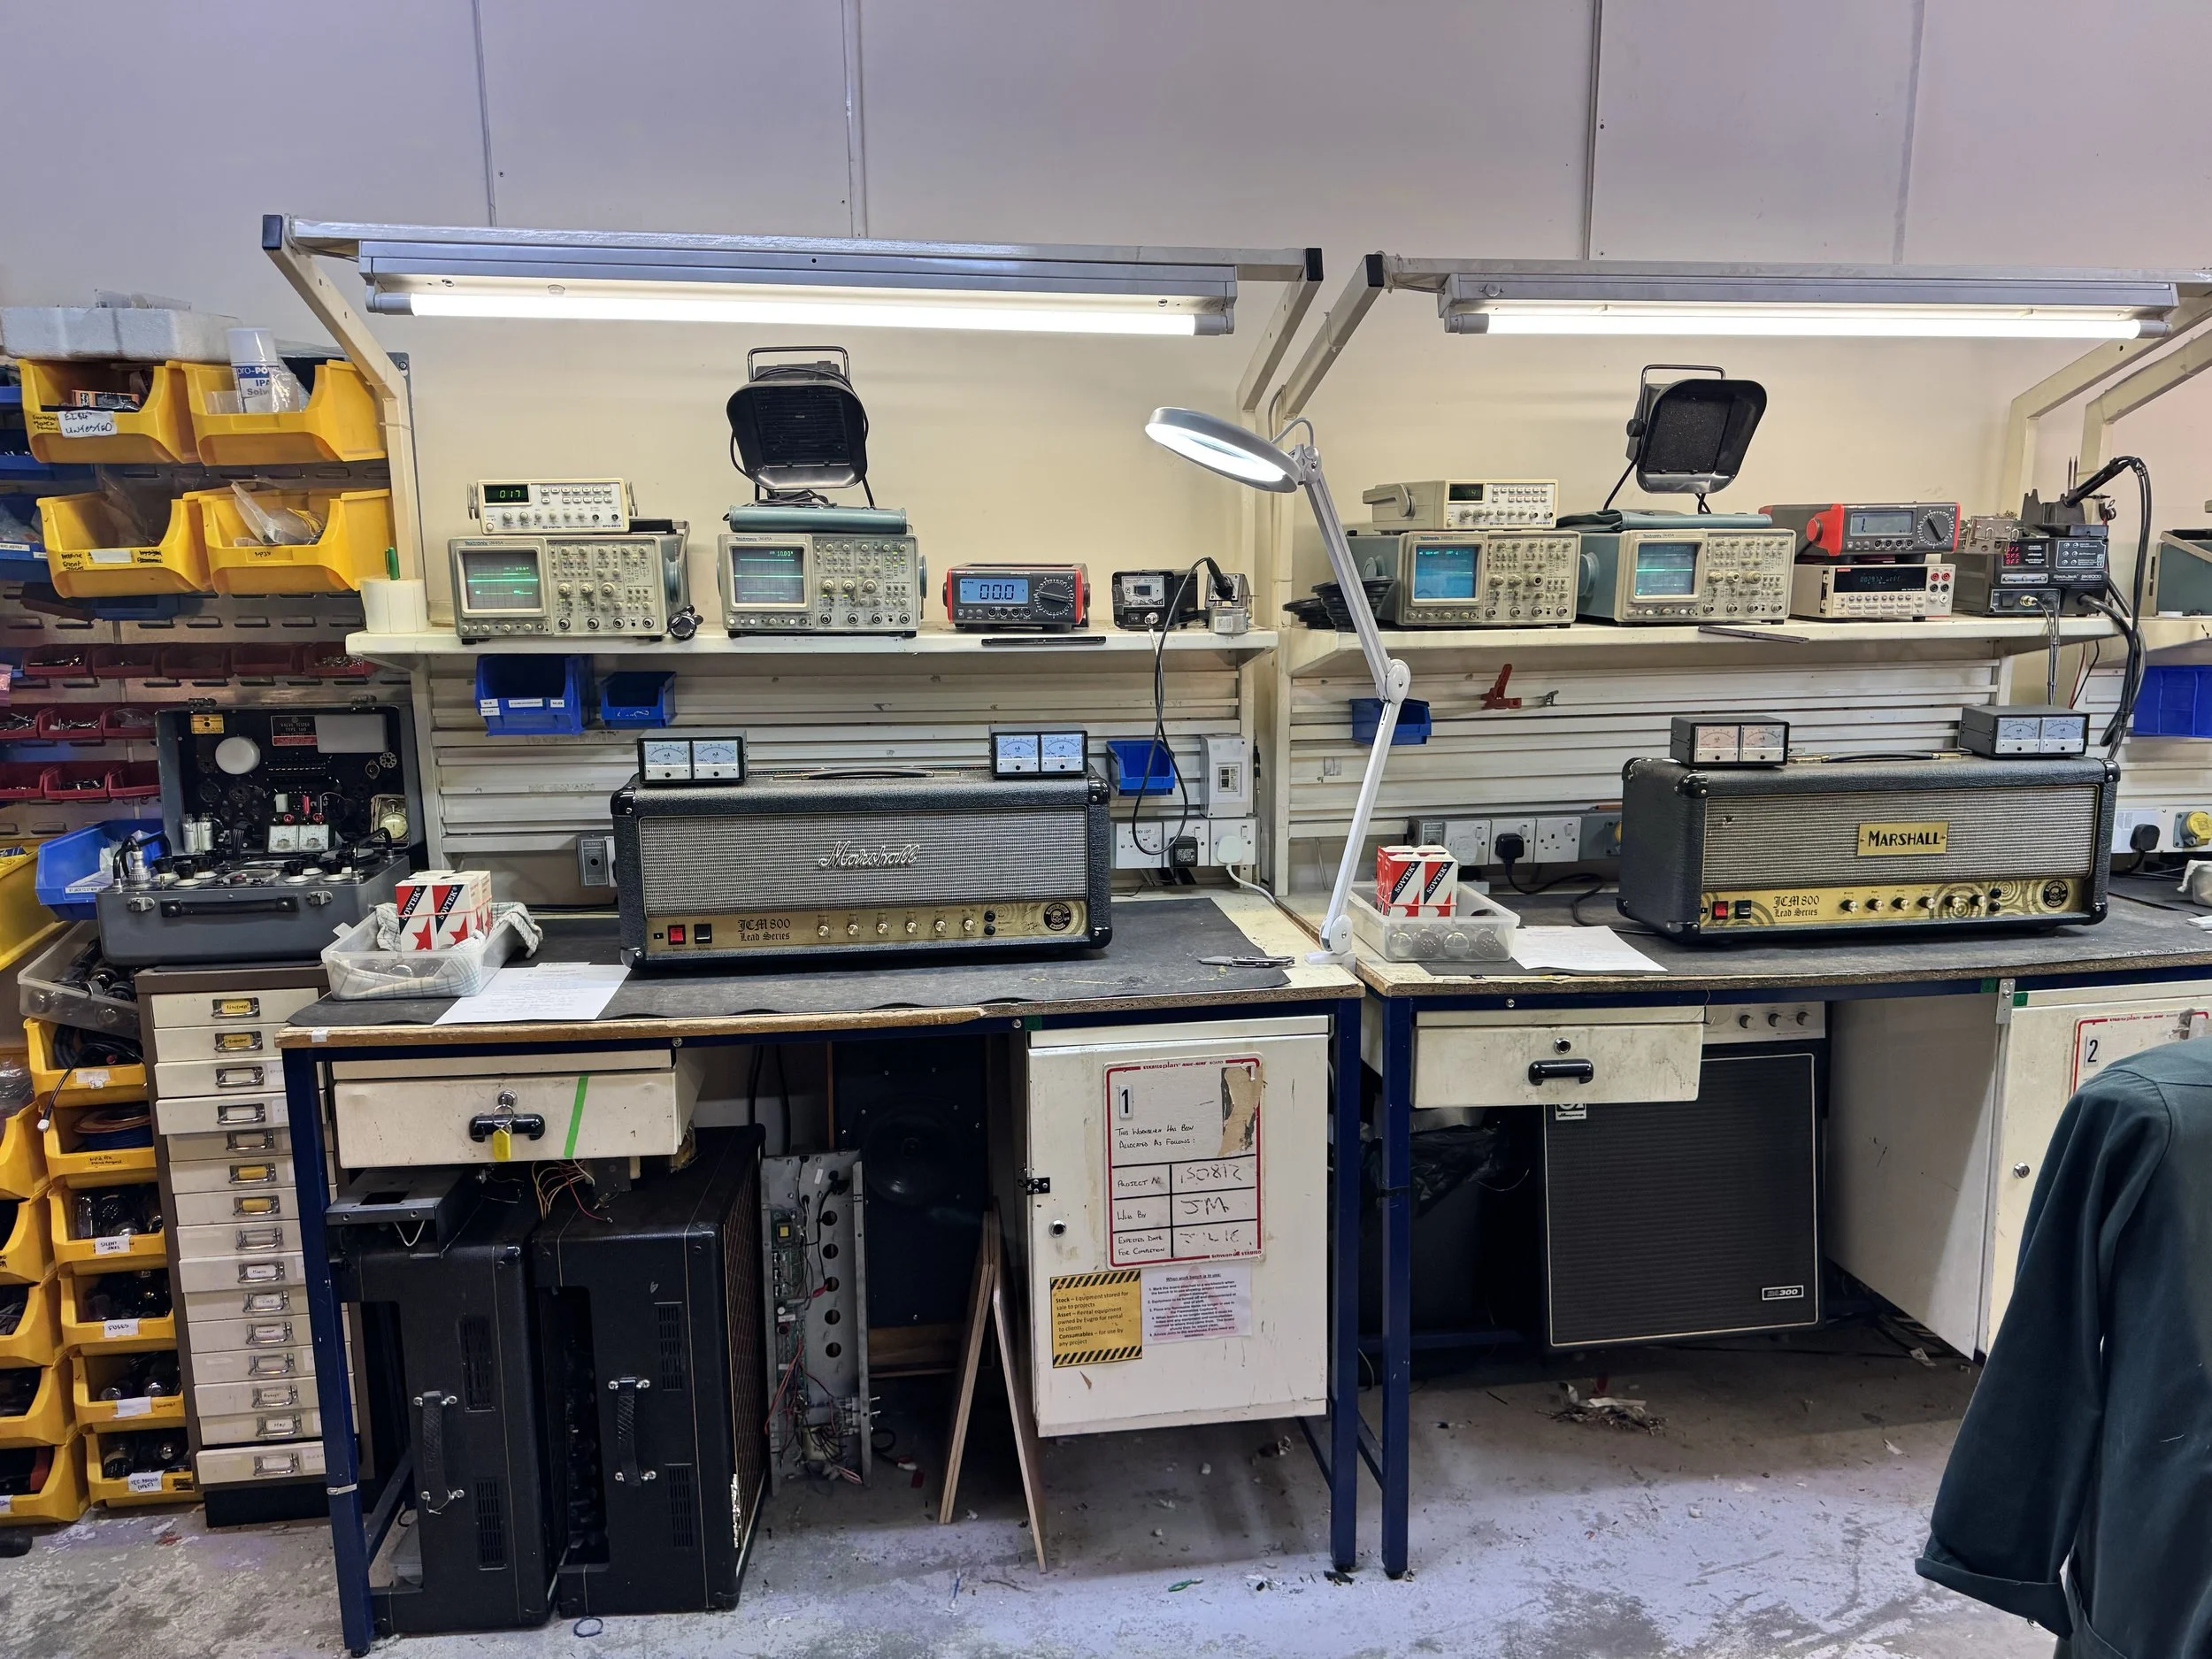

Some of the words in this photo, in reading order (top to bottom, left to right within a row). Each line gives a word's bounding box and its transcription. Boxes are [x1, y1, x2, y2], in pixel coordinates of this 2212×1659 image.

[1868, 830, 1940, 847] MARSHALL
[818, 840, 920, 868] Marshall
[1773, 895, 1800, 909] JCM
[1801, 895, 1820, 906] 800
[1774, 909, 1792, 918] Lead
[1794, 907, 1818, 917] Series
[737, 919, 768, 933] JCM
[770, 918, 791, 929] 800
[740, 932, 760, 942] Lead
[763, 932, 790, 941] Series
[2087, 1039, 2099, 1063] 2
[1121, 1088, 1129, 1114] 1
